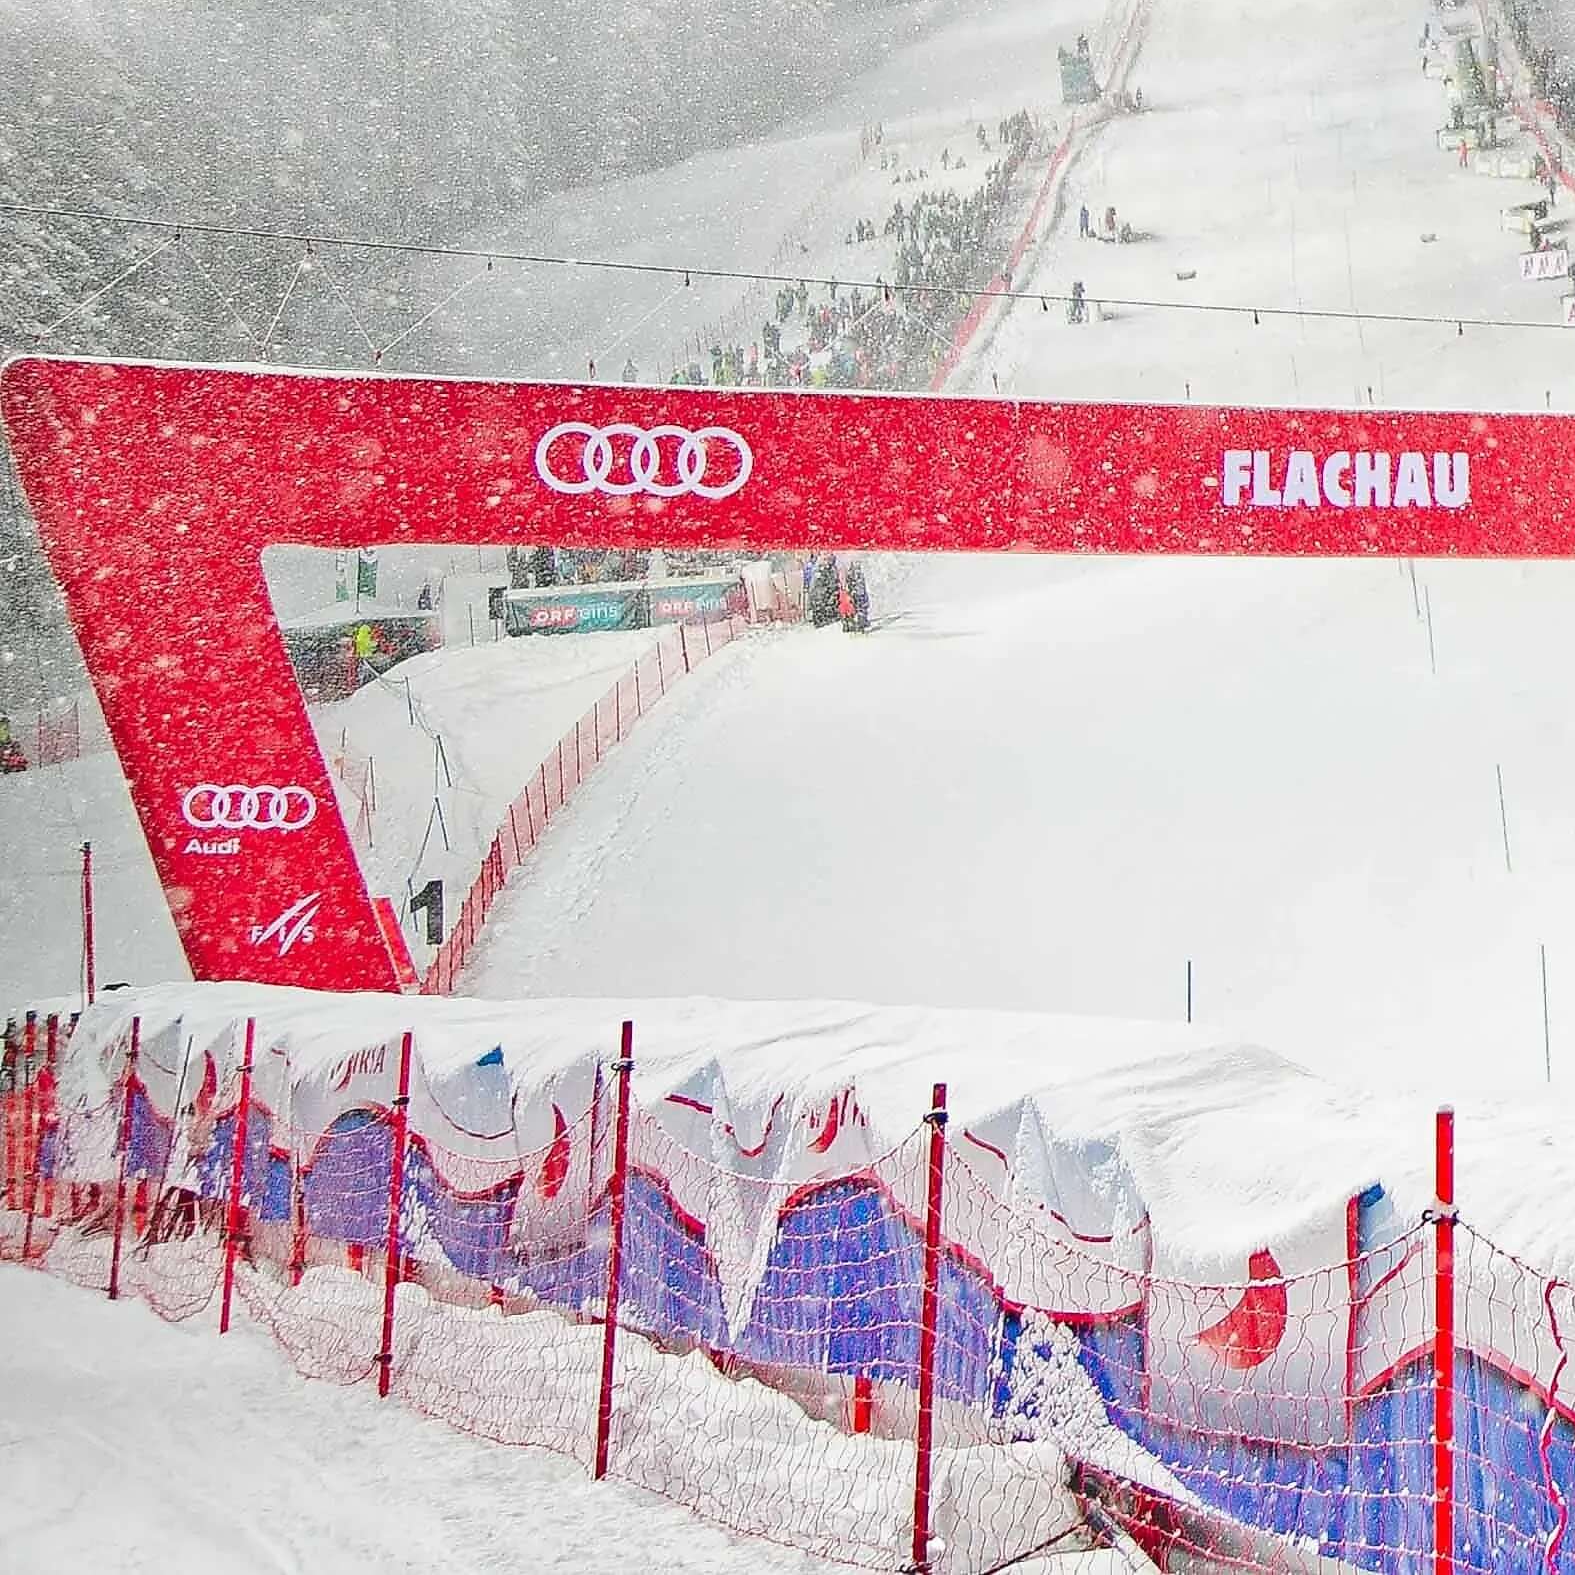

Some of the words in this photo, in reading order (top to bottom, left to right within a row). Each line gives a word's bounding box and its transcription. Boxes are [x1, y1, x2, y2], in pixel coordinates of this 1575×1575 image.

[1222, 448, 1471, 508] FLACHAU
[535, 608, 576, 623] ORF
[183, 837, 241, 855] Audi
